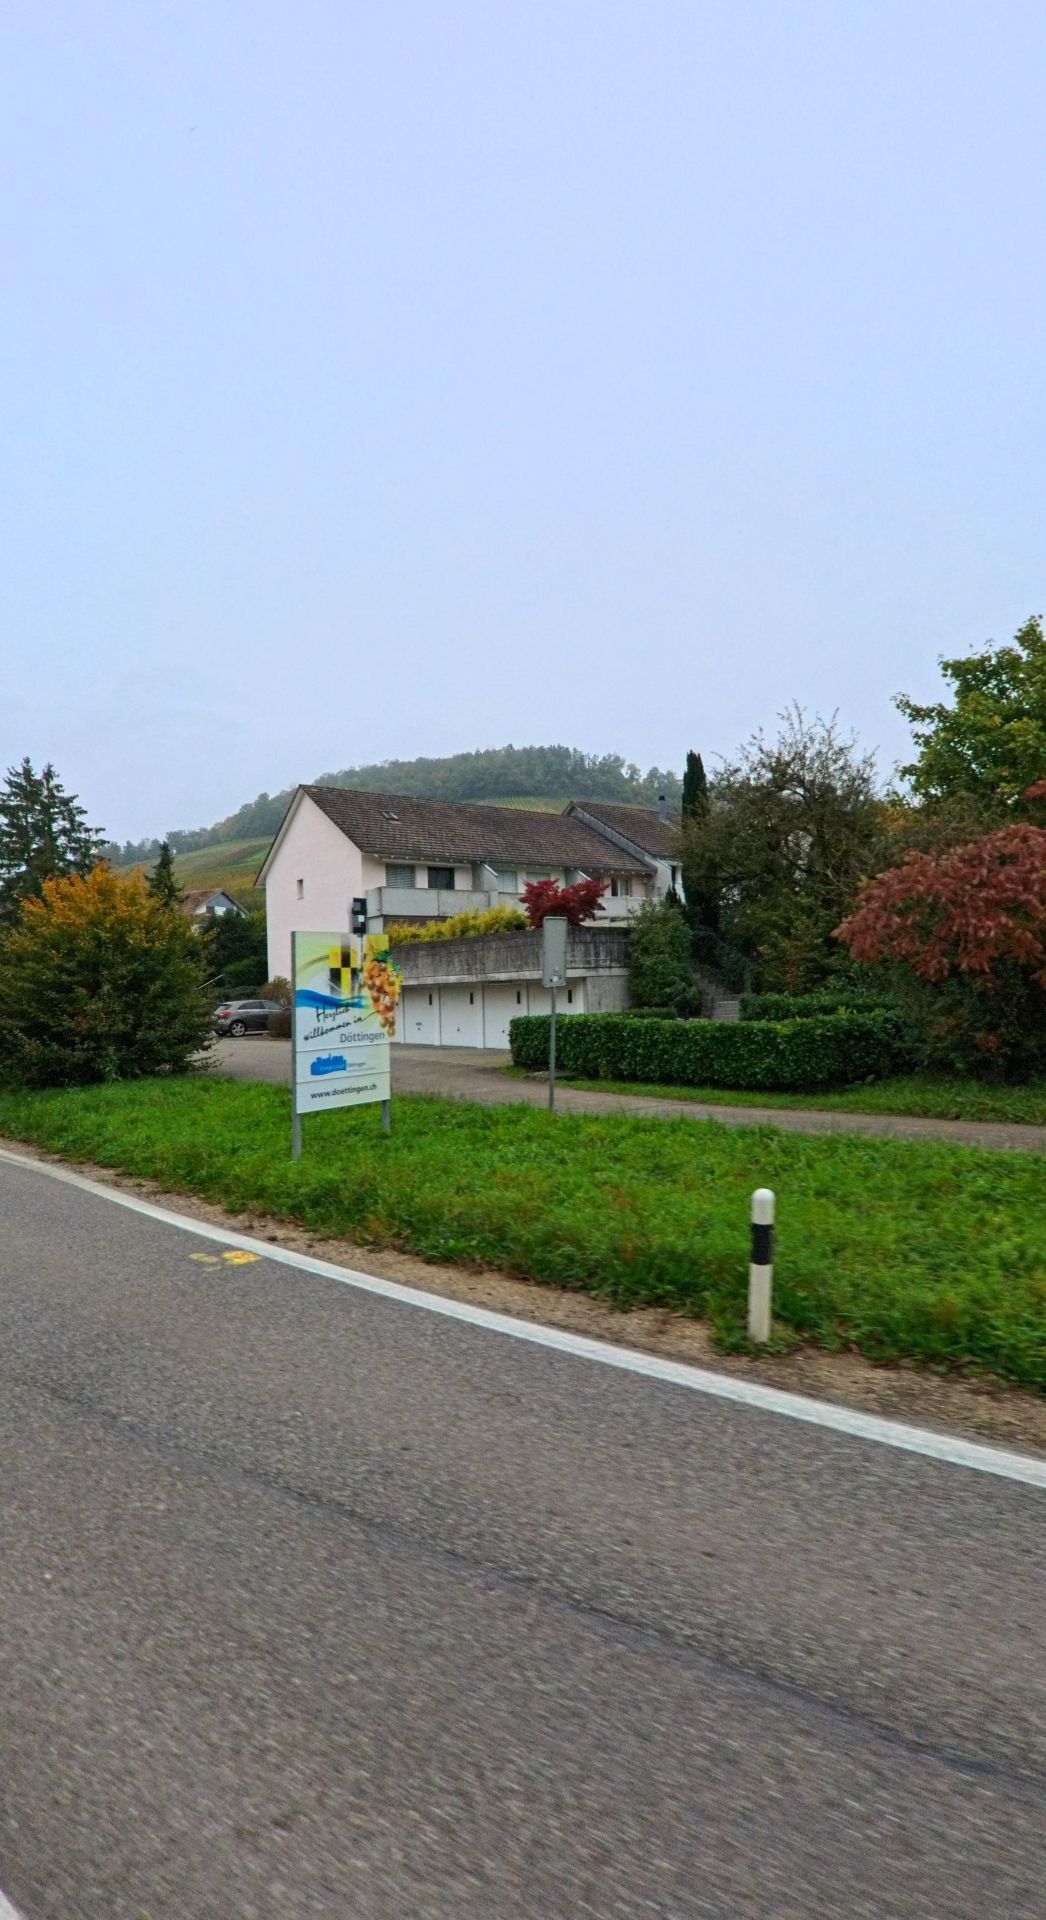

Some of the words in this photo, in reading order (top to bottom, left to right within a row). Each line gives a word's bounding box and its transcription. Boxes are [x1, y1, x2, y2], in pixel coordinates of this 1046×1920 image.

[315, 1004, 350, 1022] Herzlich
[304, 1021, 351, 1040] willkommen
[340, 1031, 385, 1043] Döttingen
[310, 1082, 377, 1099] www.doettingen.ch
